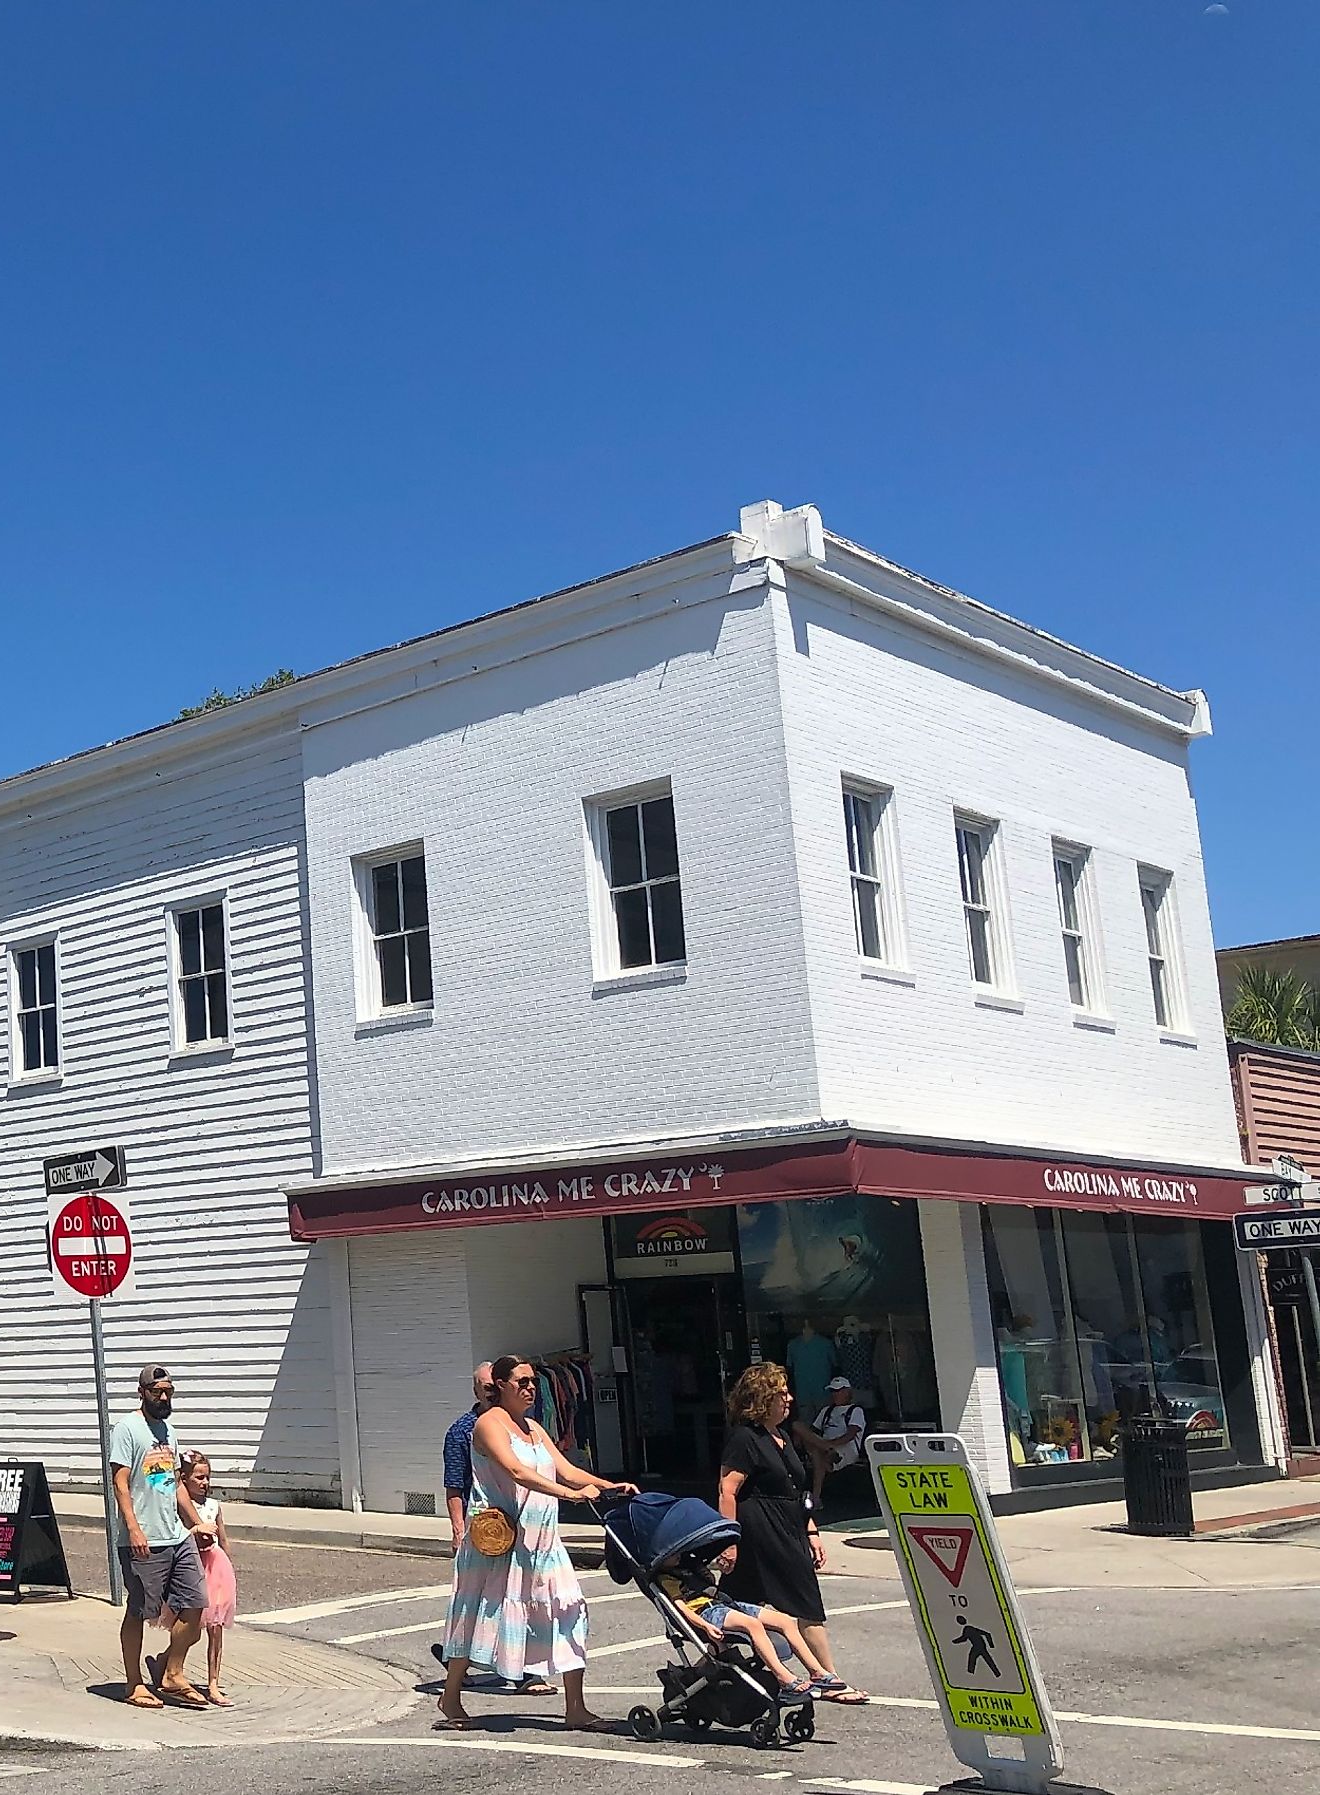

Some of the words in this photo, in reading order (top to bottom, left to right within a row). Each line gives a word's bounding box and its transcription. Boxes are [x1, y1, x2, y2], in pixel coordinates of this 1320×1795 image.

[51, 1168, 72, 1184] ONE
[74, 1162, 95, 1180] WAY
[421, 1181, 550, 1213] CAROLINA
[557, 1176, 595, 1202] ME
[604, 1166, 694, 1197] CRAZY
[1044, 1168, 1120, 1197] CAROLINA
[1120, 1176, 1143, 1199] ME
[1144, 1179, 1186, 1203] CRAZY
[63, 1216, 83, 1232] DO
[91, 1215, 118, 1231] NOT
[1249, 1222, 1284, 1238] ONE
[1288, 1219, 1320, 1235] WAY
[637, 1238, 708, 1254] RAINBOW
[71, 1260, 116, 1277] ENTER
[896, 1472, 953, 1489] STATE
[909, 1492, 948, 1509] LAW
[928, 1537, 957, 1550] YIELD
[949, 1594, 968, 1608] TO
[968, 1695, 1013, 1711] WITHIN
[959, 1711, 1033, 1729] CROSSWALK
